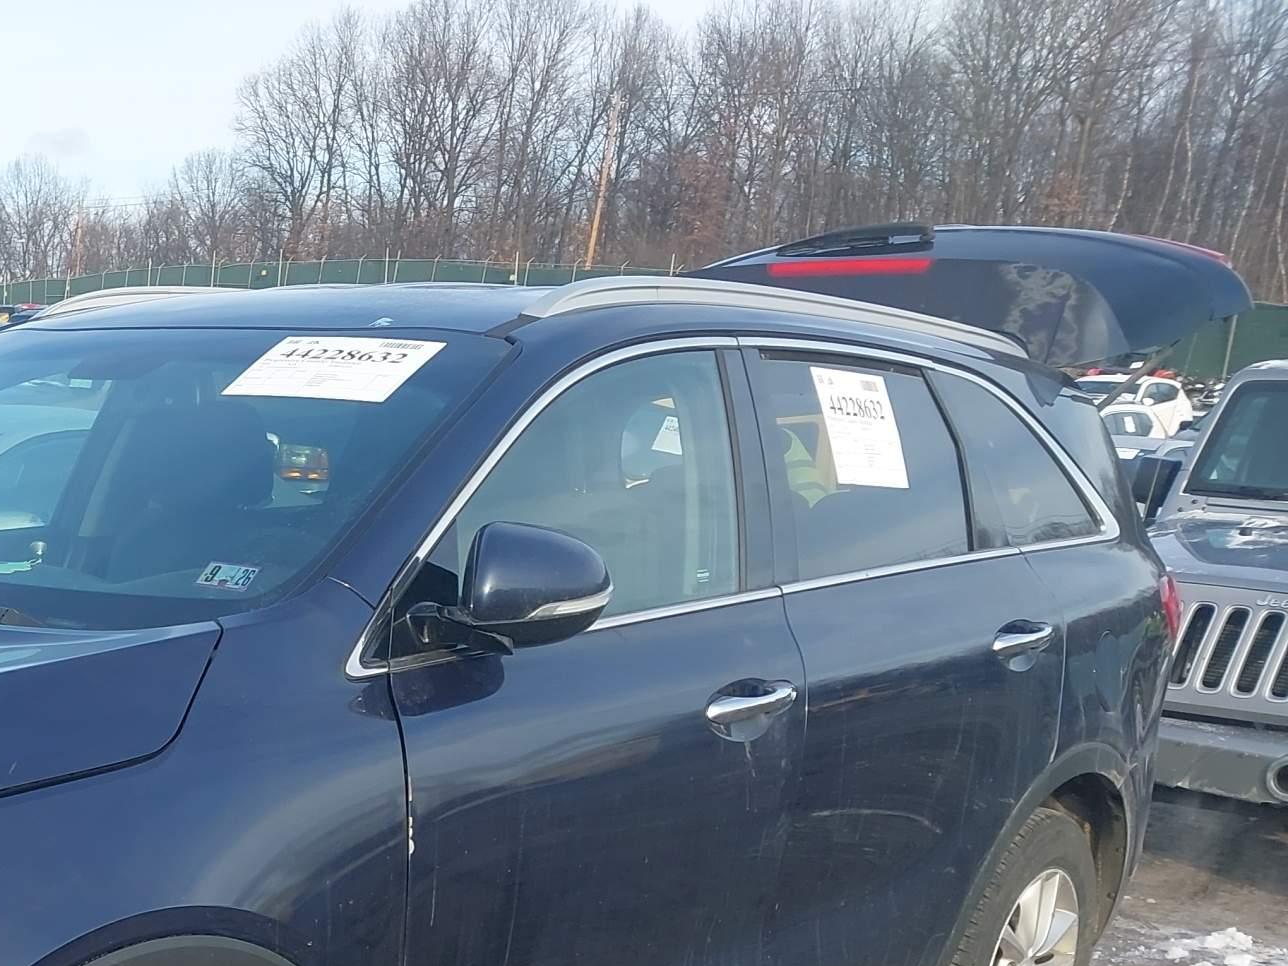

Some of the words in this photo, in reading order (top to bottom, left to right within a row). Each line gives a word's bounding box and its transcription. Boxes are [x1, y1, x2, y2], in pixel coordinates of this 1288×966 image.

[279, 347, 408, 364] 44228632
[829, 394, 886, 420] 44228632
[235, 569, 256, 586] 26
